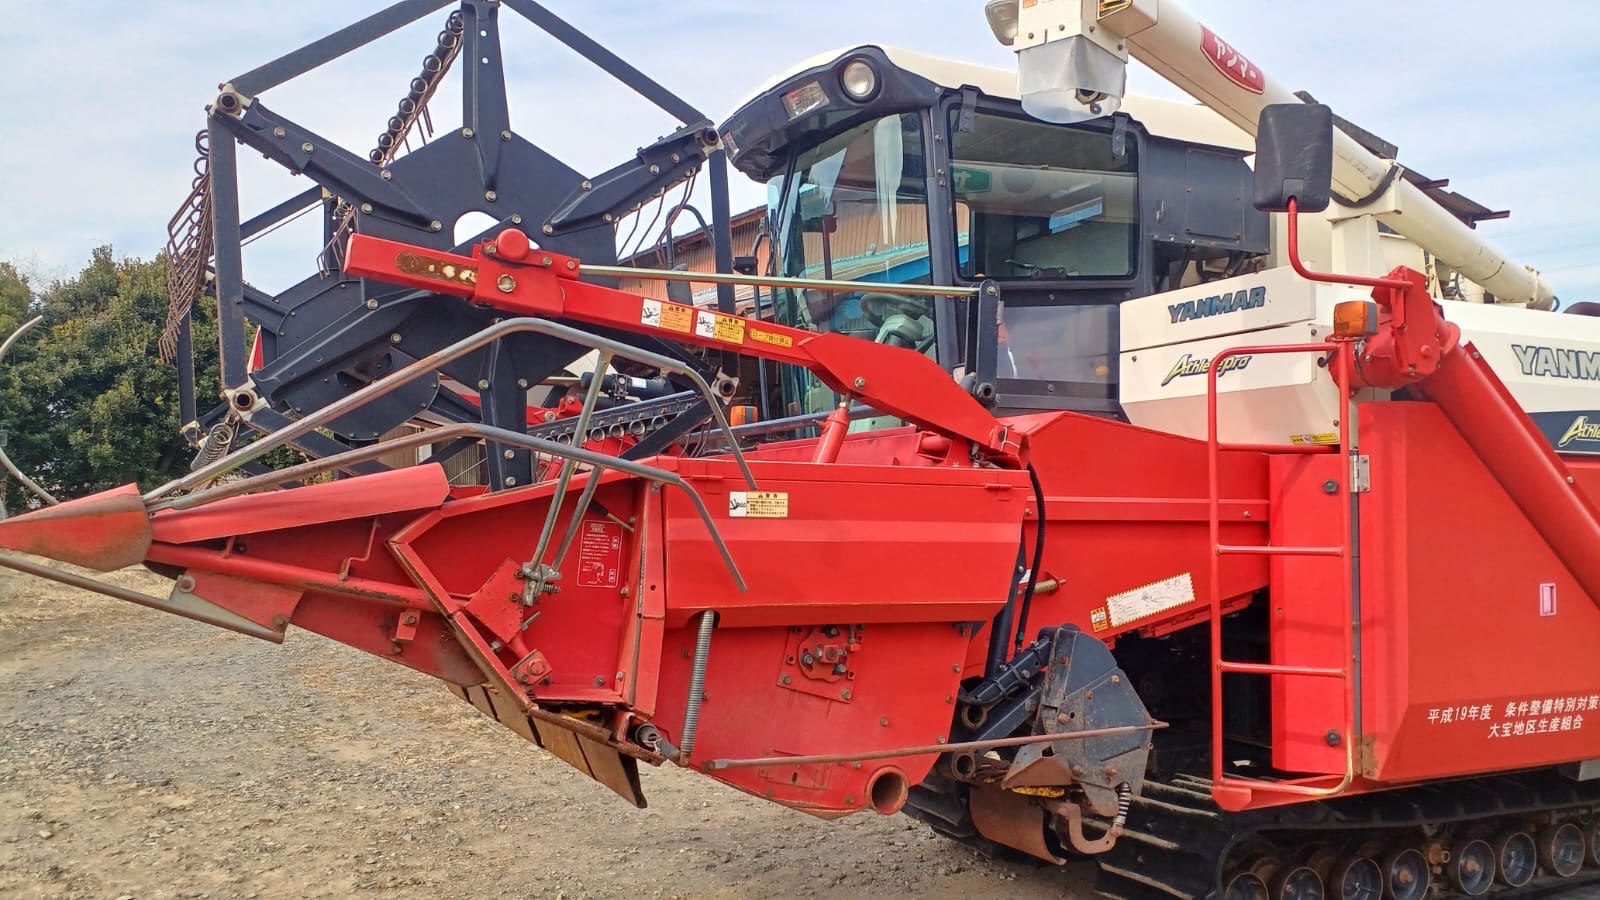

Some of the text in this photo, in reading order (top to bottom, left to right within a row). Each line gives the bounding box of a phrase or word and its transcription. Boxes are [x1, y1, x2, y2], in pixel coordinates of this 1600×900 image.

[1213, 35, 1257, 78] ヤンマー
[1168, 286, 1266, 324] YANMAR
[1427, 695, 1600, 724] 平成19年度 条件整備特別対策
[1487, 715, 1583, 739] 大宝地区生産組合
